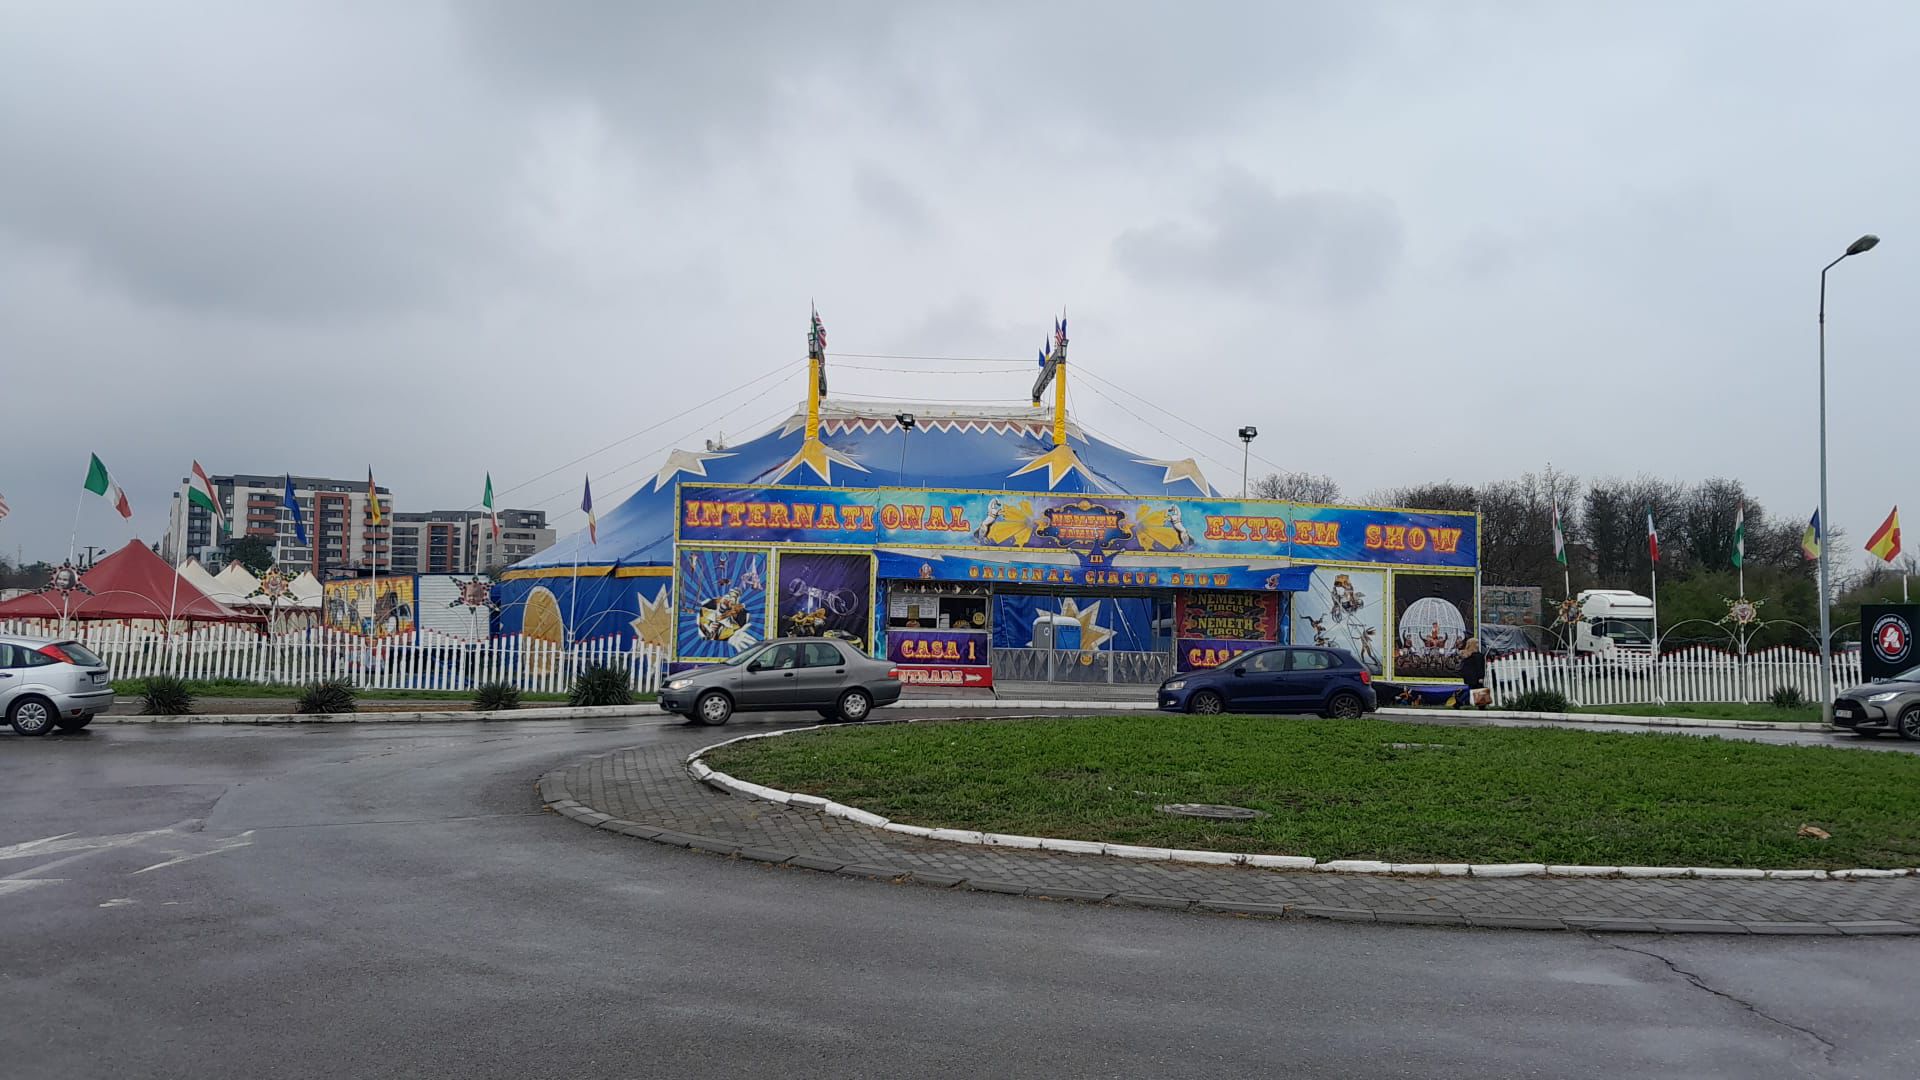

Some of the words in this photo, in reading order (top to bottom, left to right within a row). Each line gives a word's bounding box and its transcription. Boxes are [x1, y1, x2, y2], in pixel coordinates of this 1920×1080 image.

[1365, 525, 1462, 553] SHOW
[969, 566, 1073, 582] ORIGINAL
[1085, 570, 1158, 585] CIRCUS
[1171, 573, 1231, 586] SHOW
[1198, 617, 1253, 630] NEMETH
[1207, 628, 1244, 637] CIRCUS
[901, 640, 960, 658] CASA
[968, 640, 976, 660] 1
[1189, 648, 1243, 668] CAS
